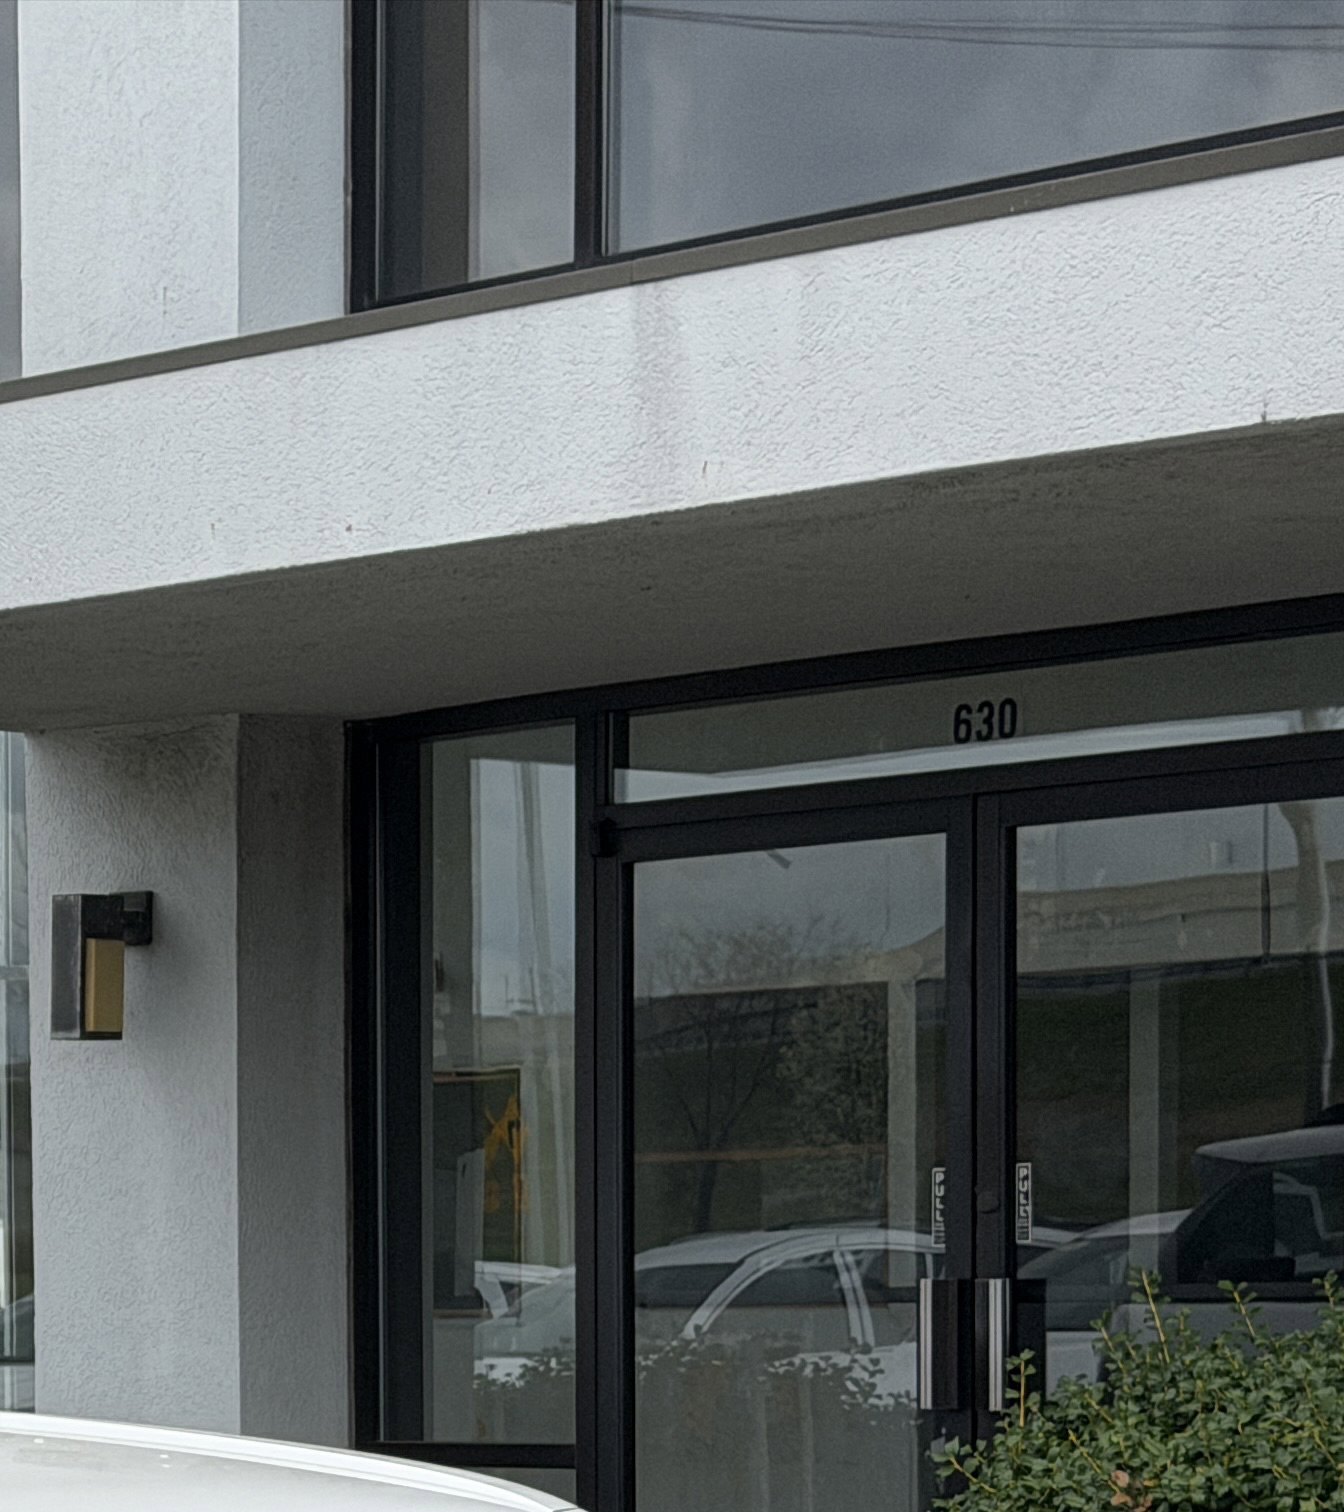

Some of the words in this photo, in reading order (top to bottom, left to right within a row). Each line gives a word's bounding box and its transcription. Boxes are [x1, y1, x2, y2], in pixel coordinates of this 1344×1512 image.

[953, 697, 1018, 744] 630
[935, 1172, 945, 1221] PULL
[1018, 1167, 1029, 1217] PULL
